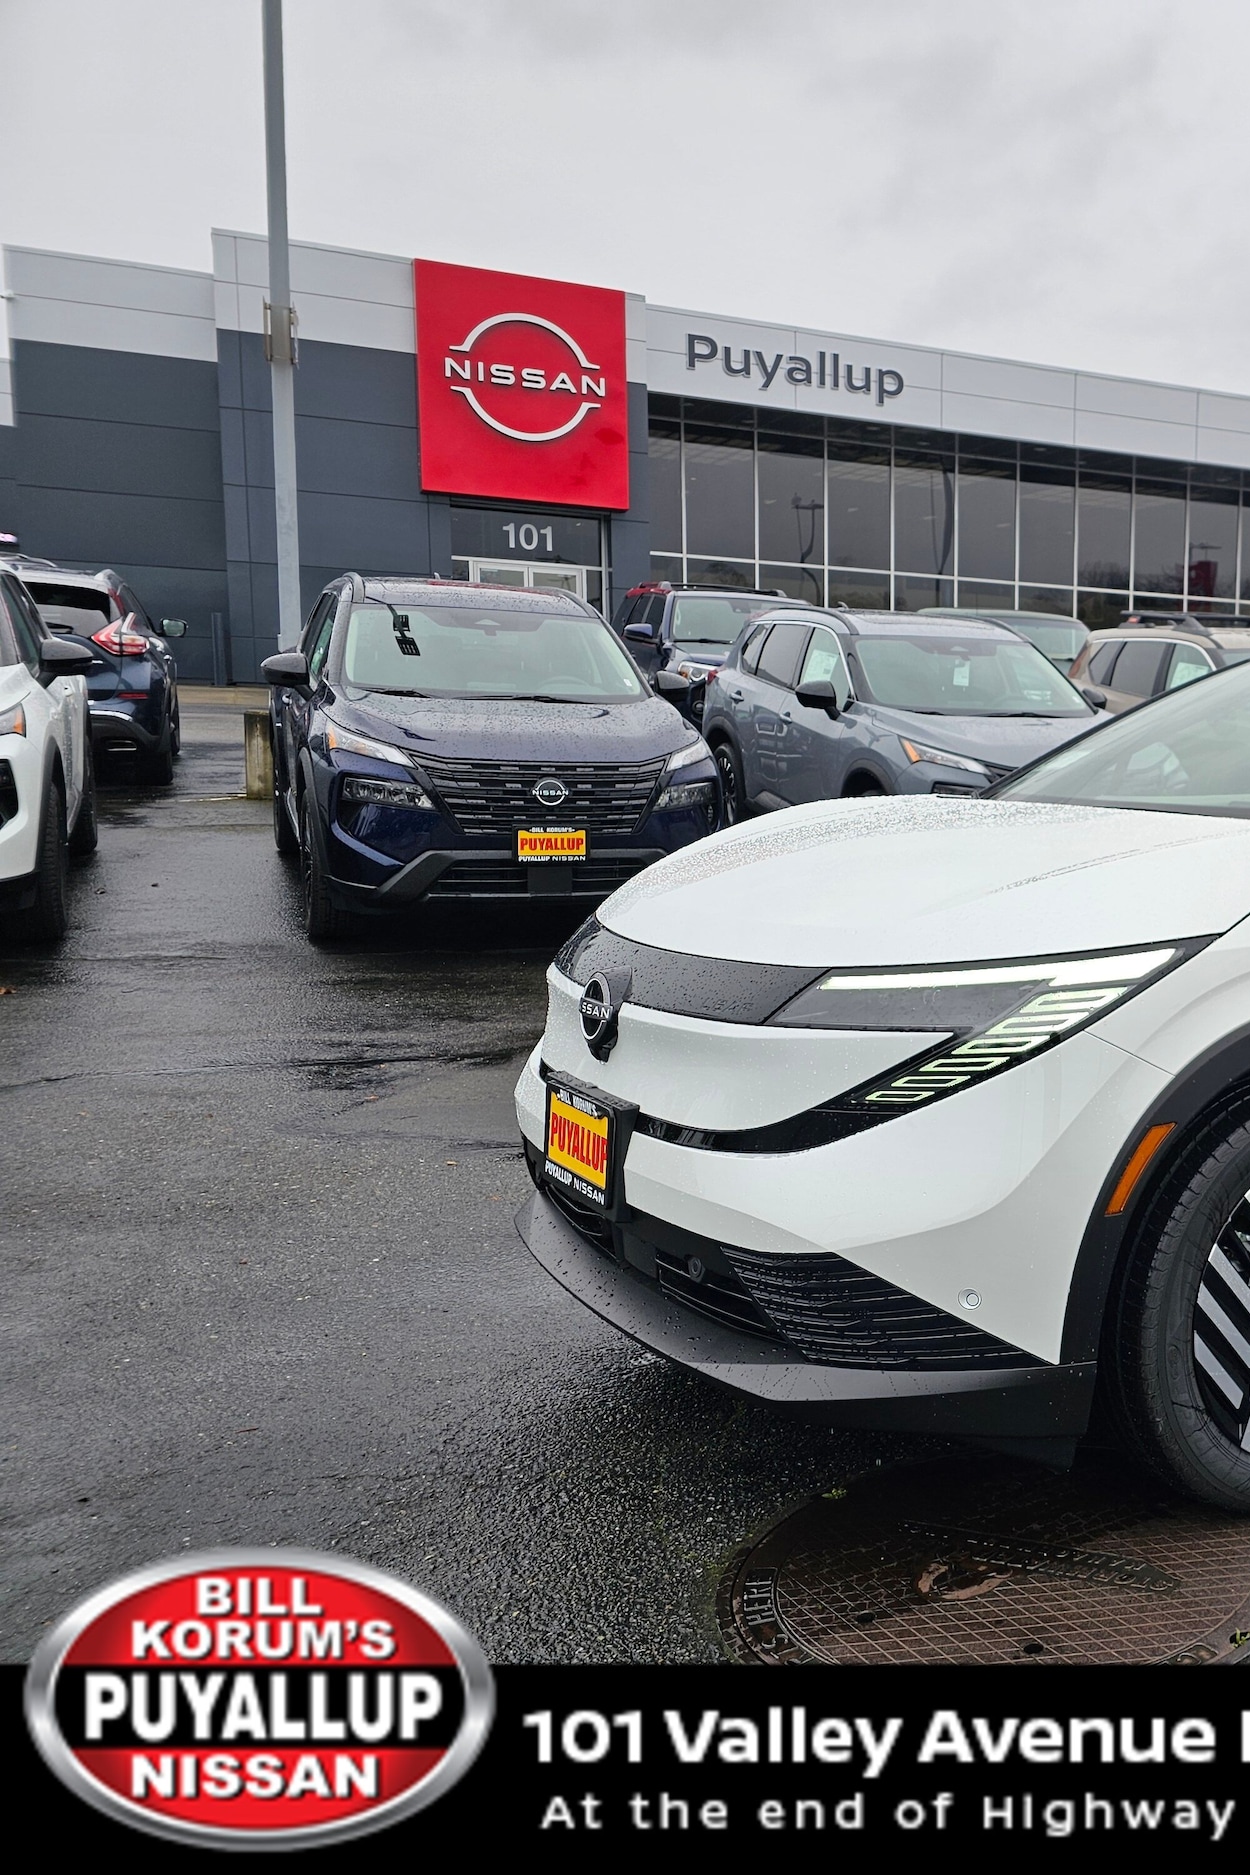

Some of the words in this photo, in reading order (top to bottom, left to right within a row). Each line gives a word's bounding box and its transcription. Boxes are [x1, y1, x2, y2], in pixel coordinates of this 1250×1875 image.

[444, 356, 606, 397] NISSAN
[685, 333, 904, 406] Puyallup
[502, 522, 553, 551] 101
[519, 837, 584, 851] PUYALLUP
[550, 1111, 608, 1174] PUYALLUP
[544, 1160, 572, 1186] PUYALLUP
[573, 1177, 606, 1206] NISSAN
